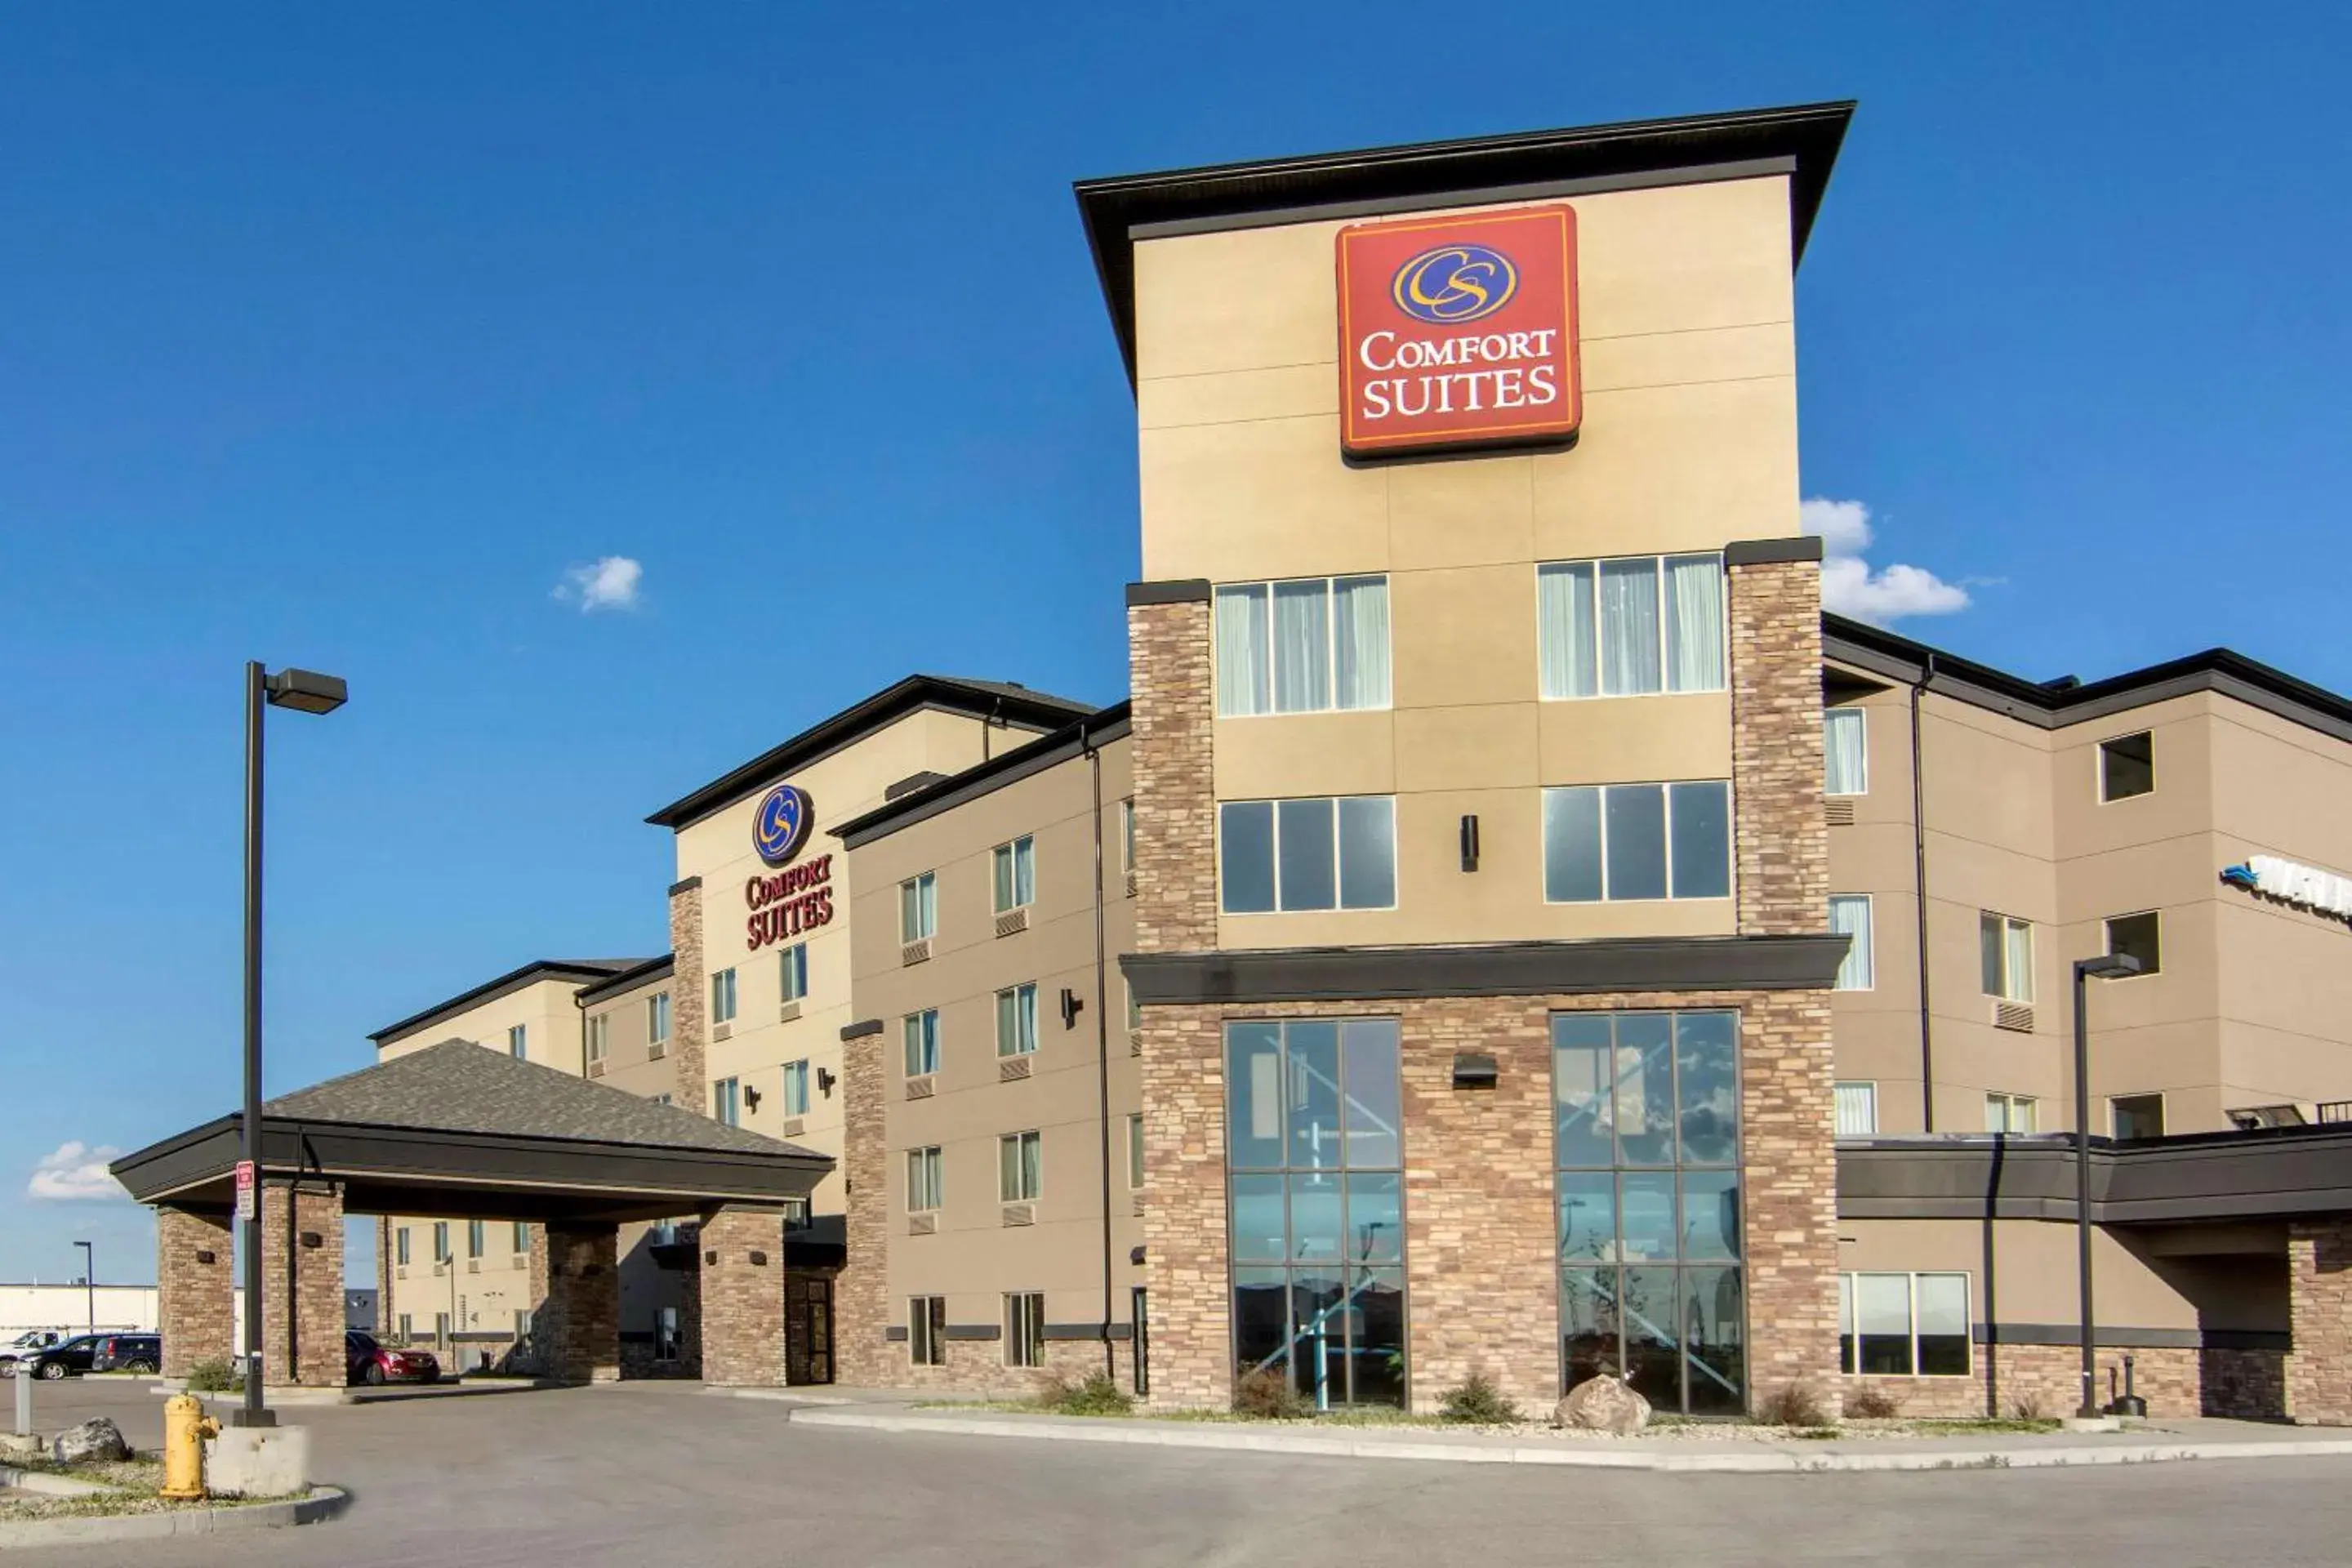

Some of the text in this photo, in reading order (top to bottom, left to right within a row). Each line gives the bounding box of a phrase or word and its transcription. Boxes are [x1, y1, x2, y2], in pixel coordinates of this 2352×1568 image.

[1360, 328, 1556, 371] COMFORT
[1362, 365, 1557, 419] SUITES
[746, 854, 833, 911] COMFORT
[747, 886, 833, 951] SUITES
